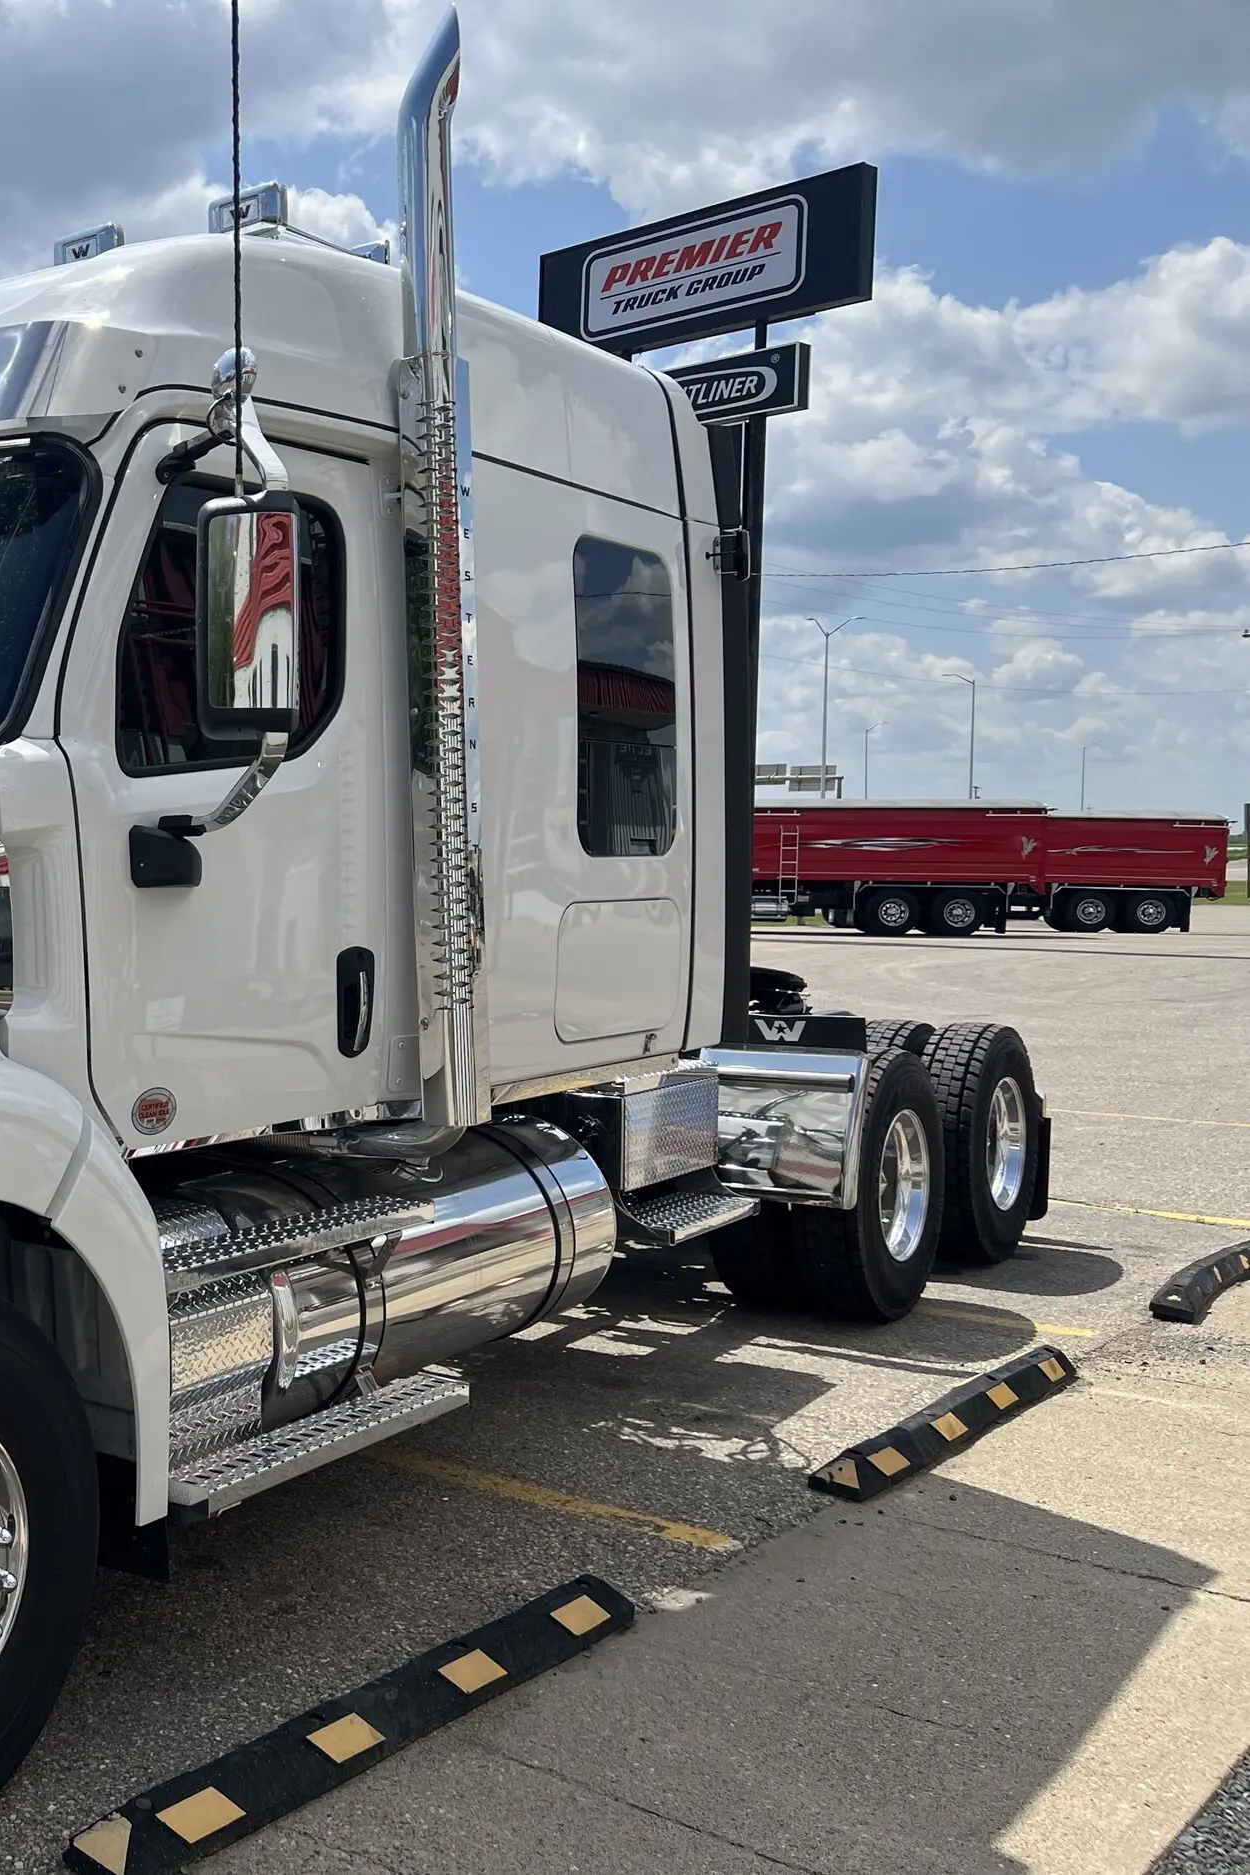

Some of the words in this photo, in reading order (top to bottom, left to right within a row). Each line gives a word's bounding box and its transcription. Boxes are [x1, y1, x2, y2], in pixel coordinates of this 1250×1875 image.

[71, 243, 90, 260] W
[601, 221, 783, 293] PREMIER
[611, 283, 684, 316] TRUCK
[684, 263, 766, 297] GROUP
[460, 485, 476, 749] WESTERN
[754, 1019, 806, 1042] W
[139, 1111, 157, 1119] CLEAN
[141, 1101, 169, 1111] CERTIFIED
